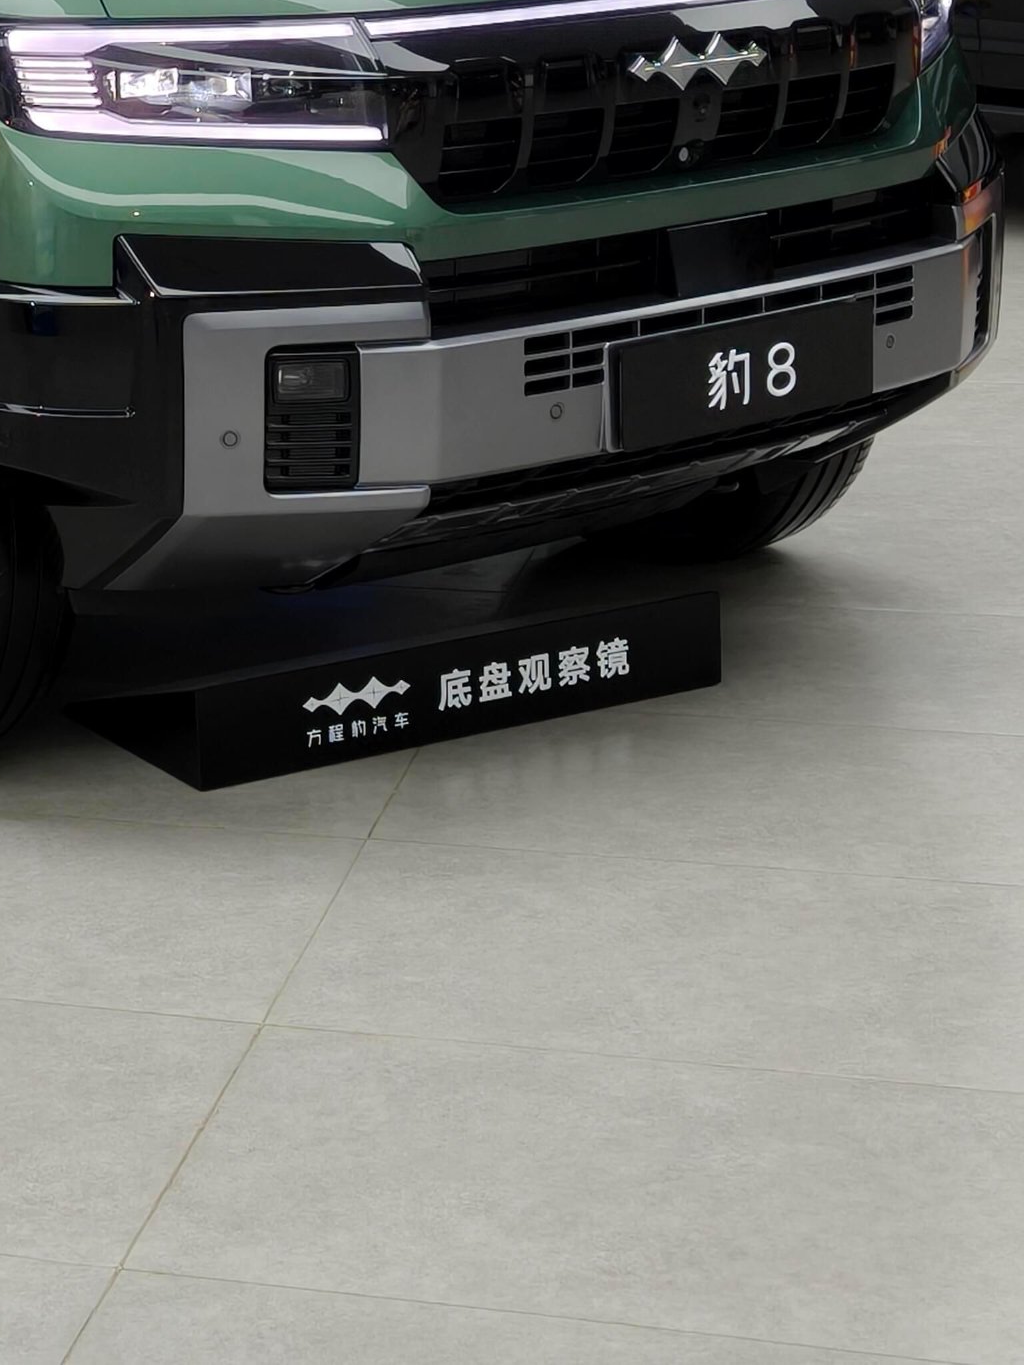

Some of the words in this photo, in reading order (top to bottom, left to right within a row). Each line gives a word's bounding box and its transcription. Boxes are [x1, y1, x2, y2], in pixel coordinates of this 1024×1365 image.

[437, 636, 630, 711] 底盘观察镜
[306, 711, 410, 748] 方程豹汽车
